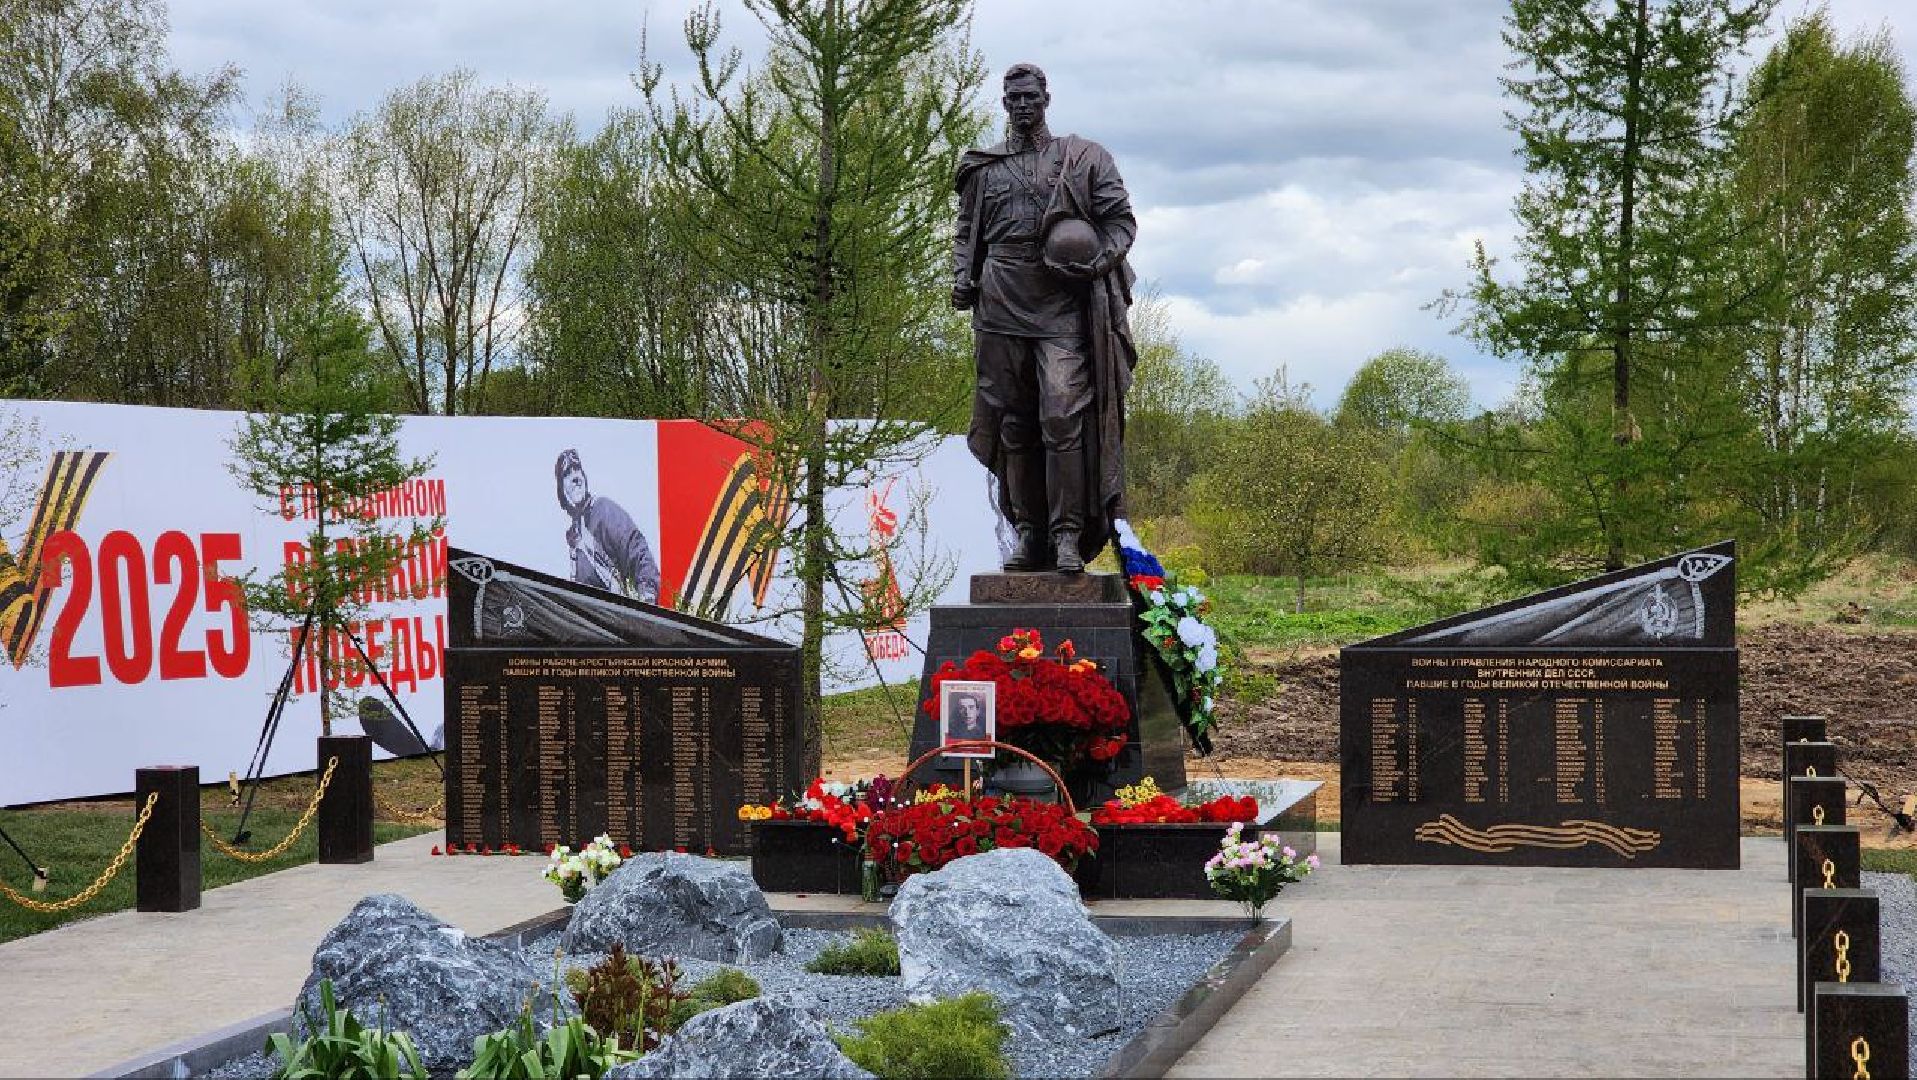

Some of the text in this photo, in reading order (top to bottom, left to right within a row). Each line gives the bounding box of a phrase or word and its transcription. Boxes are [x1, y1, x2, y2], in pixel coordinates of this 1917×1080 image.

[279, 483, 296, 522] С
[41, 530, 251, 689] 2025
[290, 614, 444, 696] ПОБЕДЫ
[652, 657, 694, 667] КРАСНОЙ
[1411, 659, 1663, 668] ВОИНЫ УПРАВЛЕНИЯ НАРОДНОГО КОМИССАРИАТА
[551, 669, 577, 678] ГОДЫ
[579, 668, 621, 677] ВЕЛИКОЙ
[623, 668, 700, 677] ОТЕЧЕСТВЕННОЙ
[1477, 669, 1542, 678] ВНУТРЕННИХ
[1544, 669, 1565, 679] ДЕЛ
[1407, 679, 1669, 690] ПАВШИЕ В ГОДЫ ВЕЛИКОЙ ОТЕЧЕСТВЕННОЙ ВОЙНЫ
